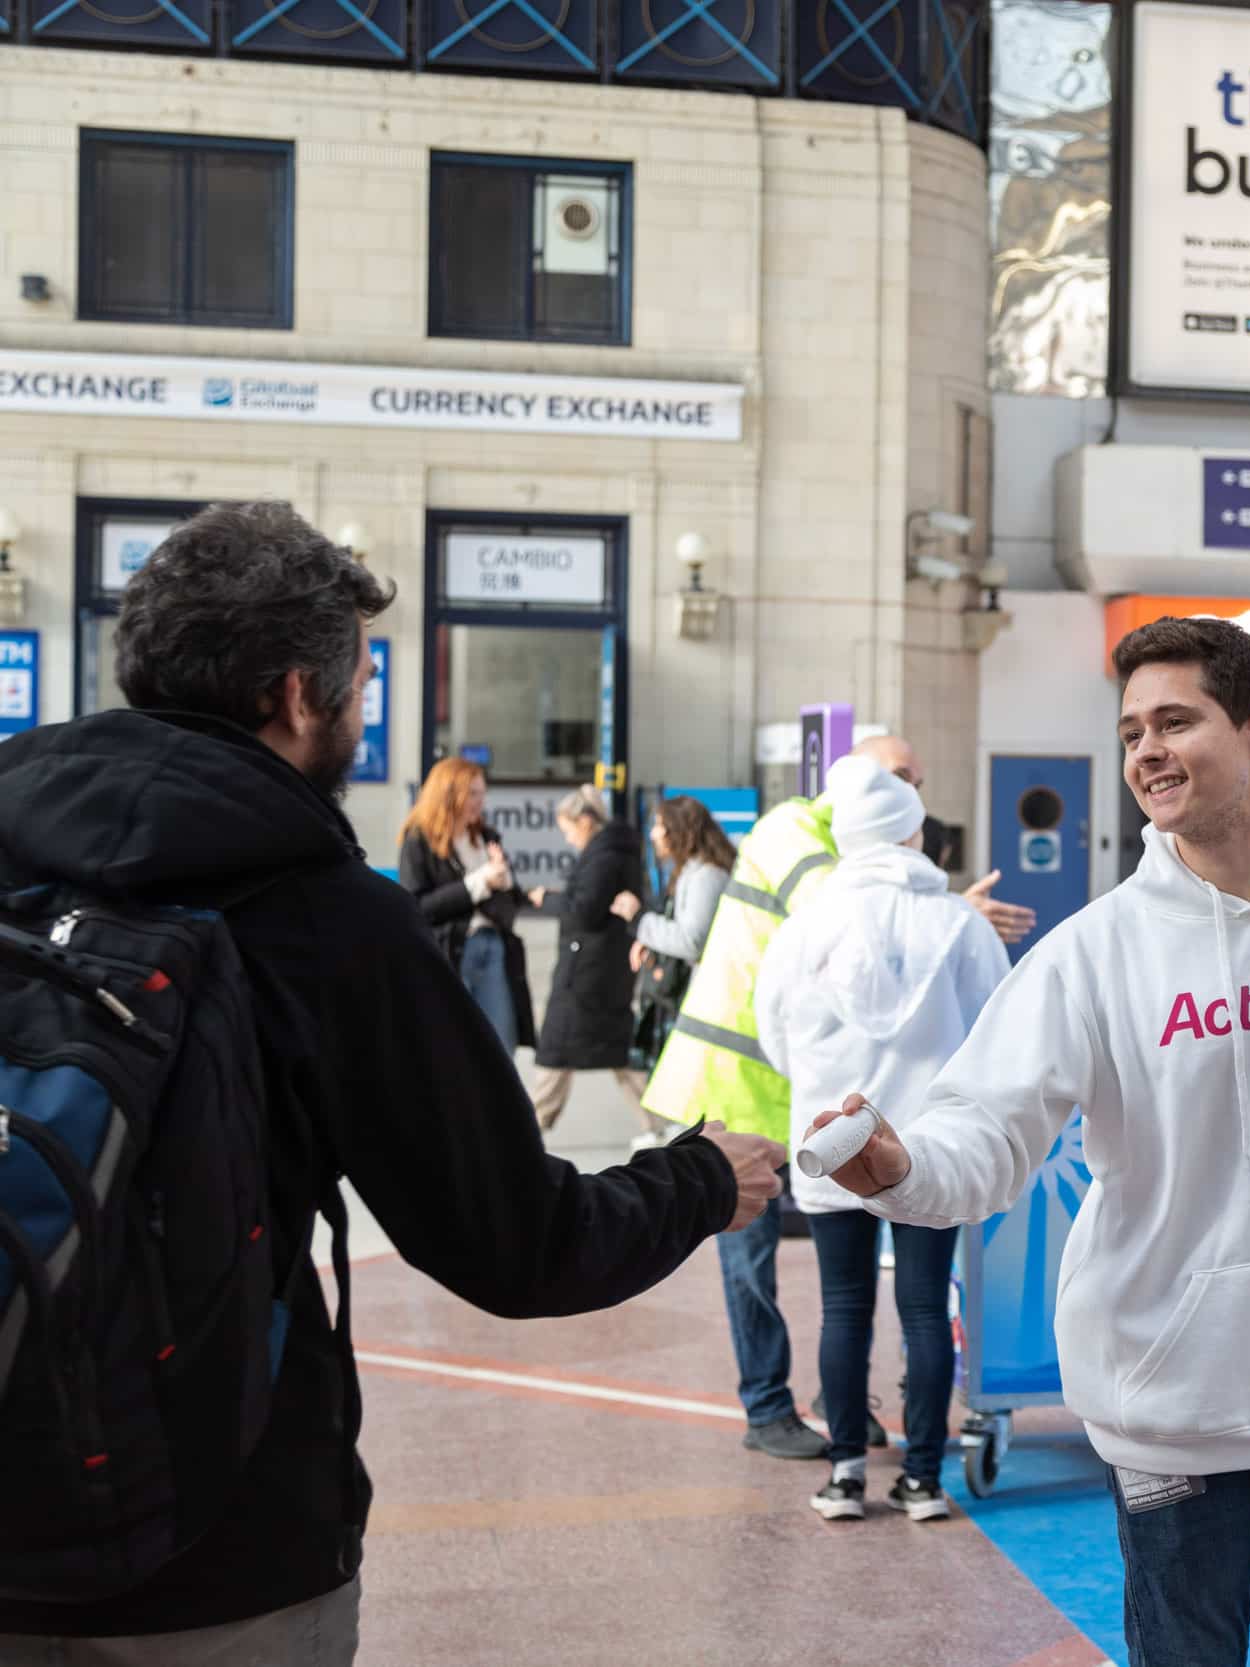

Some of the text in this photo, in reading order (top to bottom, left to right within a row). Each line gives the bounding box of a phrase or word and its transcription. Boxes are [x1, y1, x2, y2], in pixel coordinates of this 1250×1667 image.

[370, 386, 713, 426] CURRENCY EXCHANGE
[478, 546, 573, 571] CAMBIO
